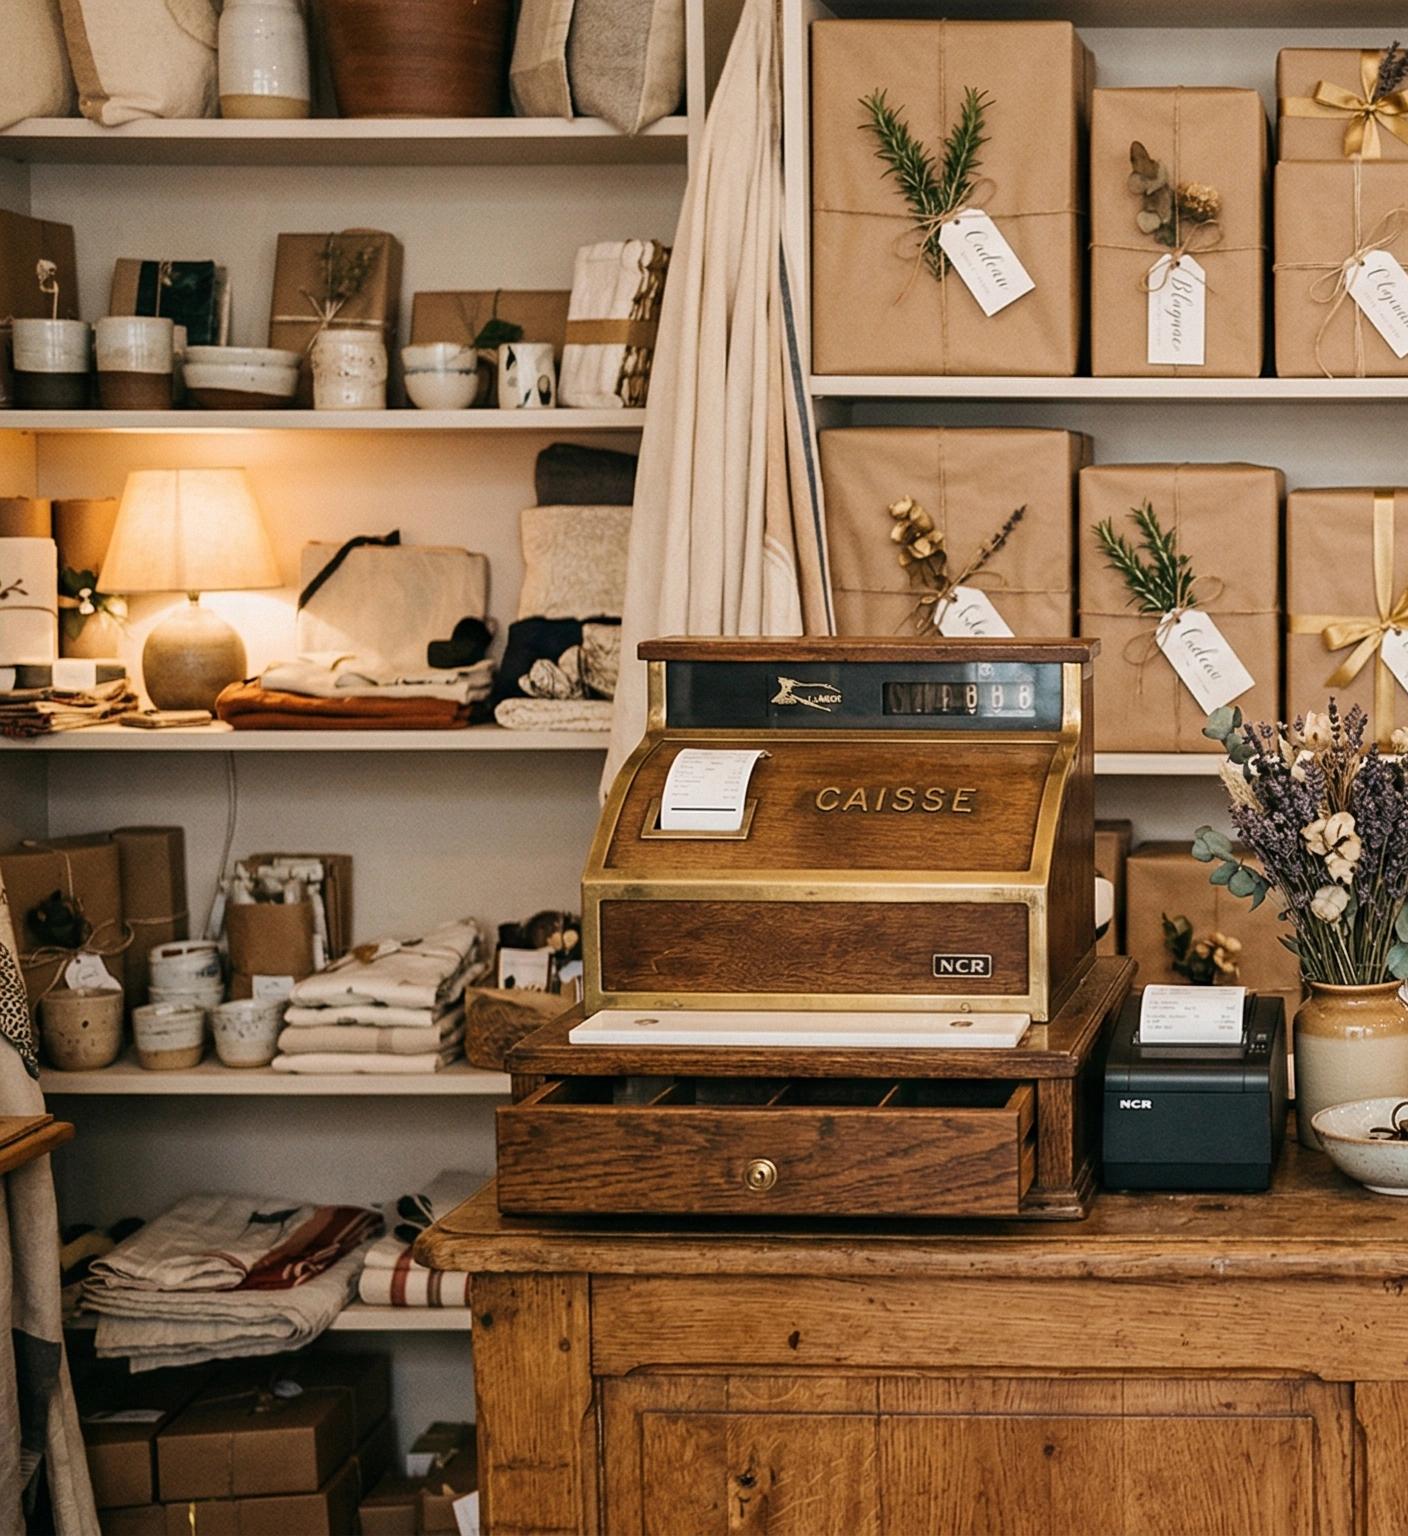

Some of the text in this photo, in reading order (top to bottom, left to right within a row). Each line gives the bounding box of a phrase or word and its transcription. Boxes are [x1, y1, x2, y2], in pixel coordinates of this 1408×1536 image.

[815, 786, 977, 813] CAISSE
[939, 958, 985, 974] NCR
[1119, 1099, 1152, 1109] NCR
